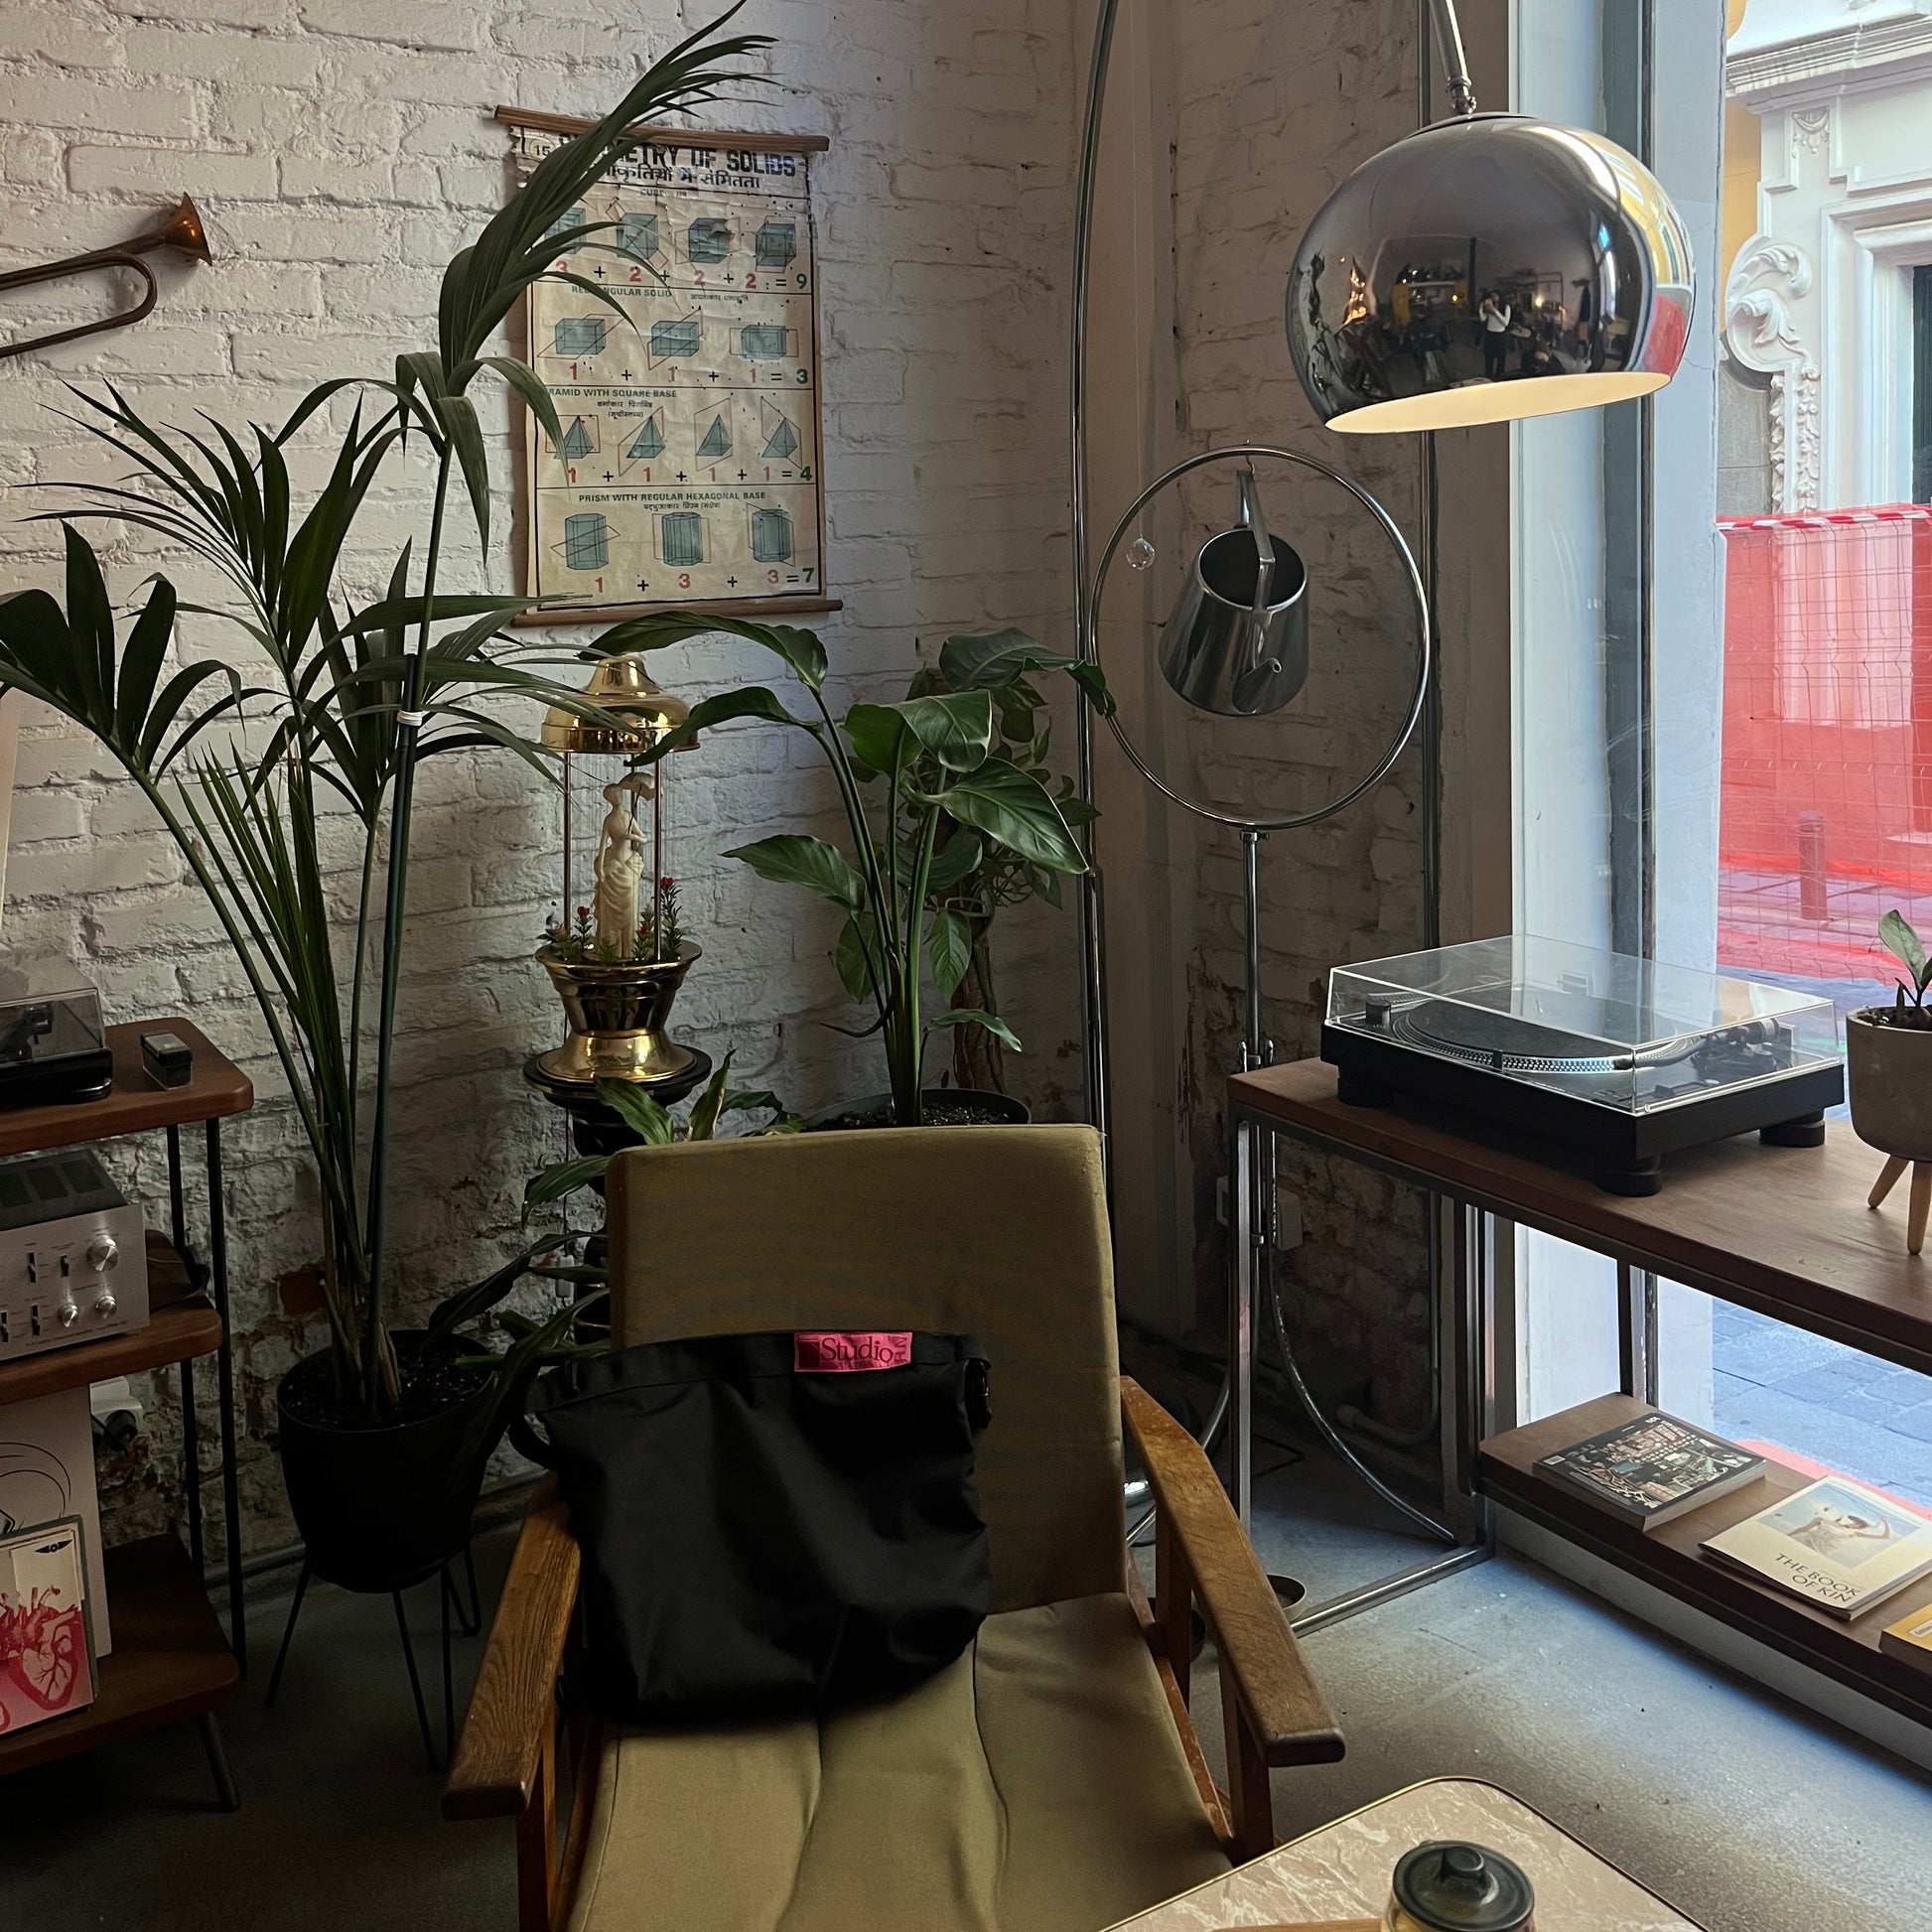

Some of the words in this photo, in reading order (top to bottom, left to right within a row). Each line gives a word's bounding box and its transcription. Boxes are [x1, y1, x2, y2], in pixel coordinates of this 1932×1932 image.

[534, 145, 551, 156] 15
[691, 149, 716, 169] OF
[726, 150, 796, 177] SOLIDS
[629, 266, 641, 282] 2
[694, 270, 706, 286] 2
[746, 273, 757, 289] 2
[796, 273, 808, 290] 9
[643, 289, 672, 298] SOLID
[569, 362, 578, 380] 1
[668, 366, 676, 382] 1
[749, 368, 757, 383] 1
[796, 369, 808, 384] 3
[548, 388, 581, 397] RAMID
[584, 388, 610, 397] WITH
[613, 389, 650, 398] SQUARE
[568, 468, 577, 483] 1
[643, 468, 651, 483] 1
[709, 467, 716, 483] 1
[763, 466, 770, 482] 1
[800, 466, 812, 481] 4
[640, 492, 683, 501] REGULAR
[686, 491, 739, 500] HEXAGONAL
[595, 577, 604, 593] 1
[678, 573, 691, 589] 3
[767, 569, 779, 585] 3
[802, 567, 815, 583] 7
[820, 1336, 895, 1363] Studio
[1775, 1553, 1809, 1575] THE
[1807, 1571, 1863, 1596] BOOK
[1792, 1575, 1819, 1589] OF
[1817, 1587, 1853, 1602] KIN
